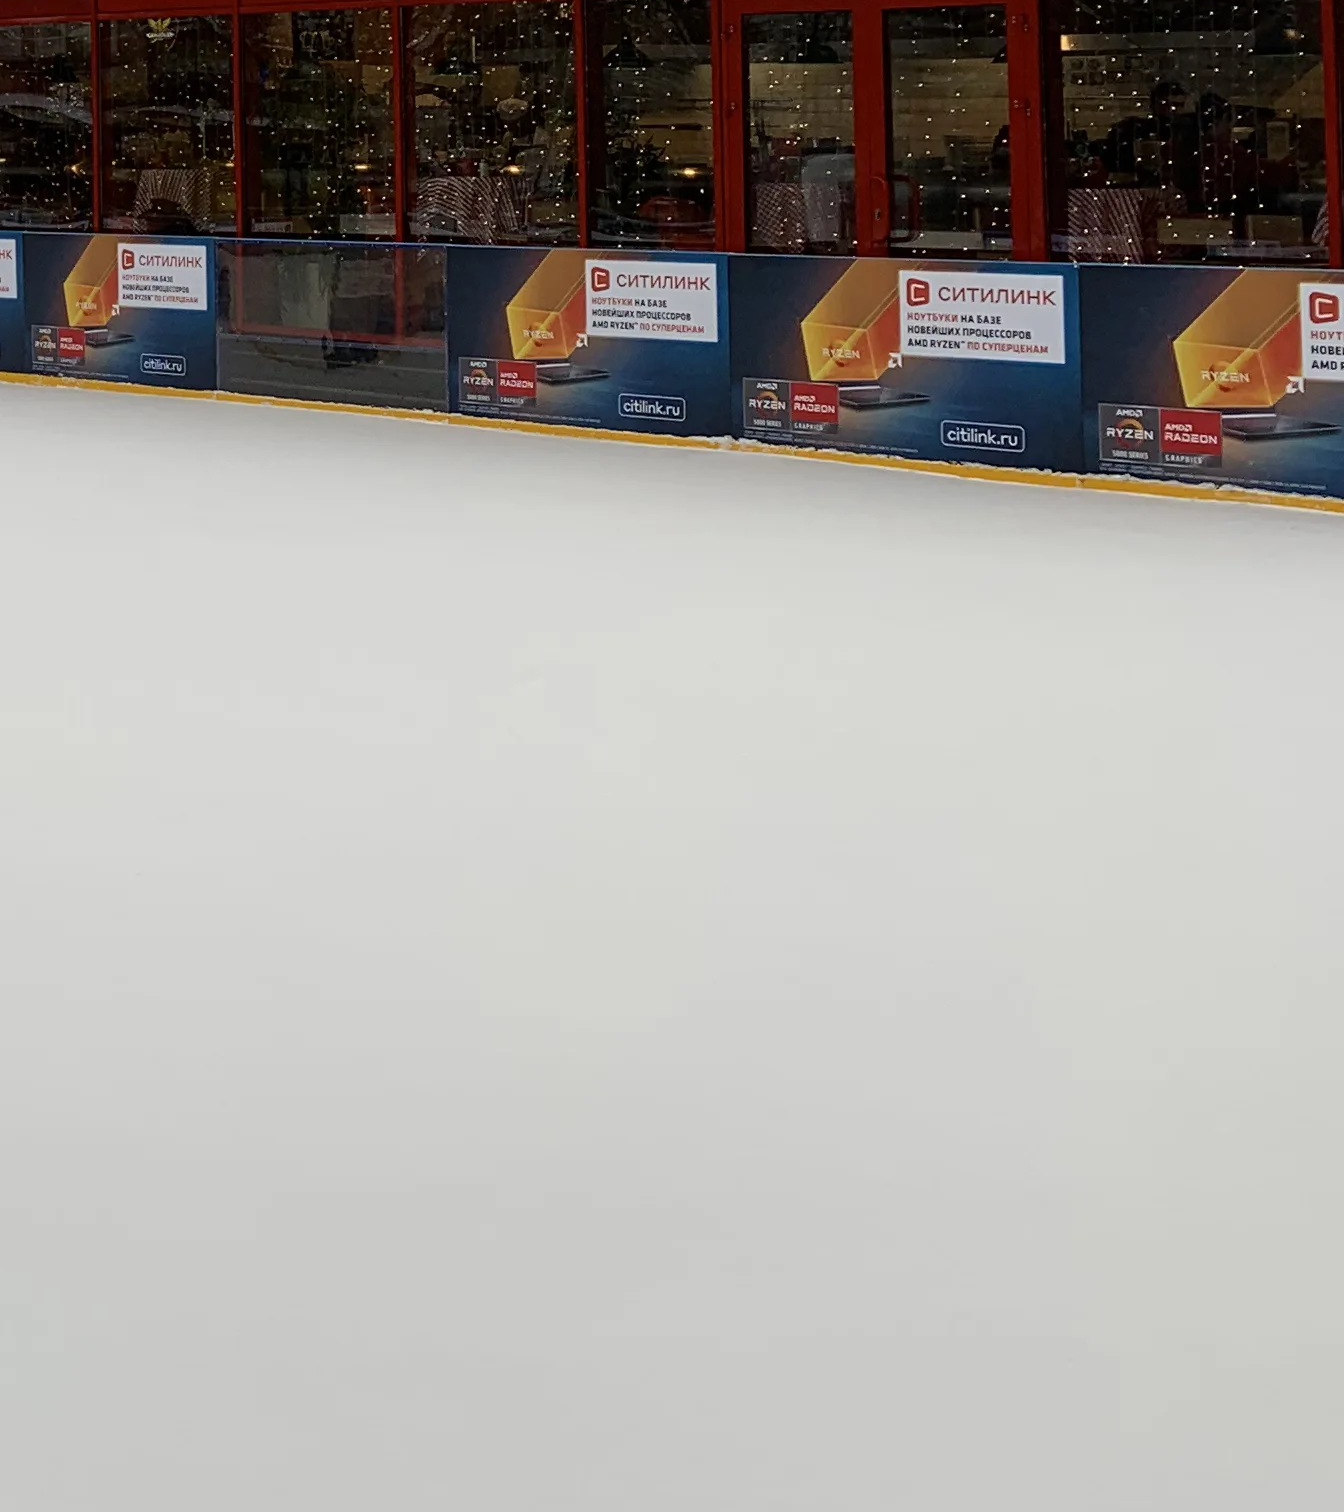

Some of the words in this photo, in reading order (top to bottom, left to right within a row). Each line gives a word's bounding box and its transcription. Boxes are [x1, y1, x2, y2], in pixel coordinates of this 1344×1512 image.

[139, 255, 203, 268] СИТИЛИНК
[616, 274, 711, 291] СИТИЛИНК
[938, 286, 1056, 306] СИТИЛИНК
[591, 297, 633, 306] НОУТБУКИ
[634, 299, 646, 307] НА
[647, 299, 668, 308] БАЗЕ
[592, 308, 635, 319] НОВЕЙШИХ
[635, 310, 692, 321] ПРОЦЕССОРОВ
[907, 313, 958, 323] НОУТБУКИ
[960, 315, 974, 323] НА
[977, 315, 1001, 325] БАЗЕ
[592, 321, 609, 329] AMD
[639, 323, 650, 331] ПО
[651, 324, 705, 335] СУПЕРЦЕНАМ
[907, 325, 961, 336] НОВЕЙШИХ
[963, 328, 1032, 340] ПРОЦЕССОРОВ
[1310, 331, 1344, 341] НОУТ
[822, 347, 861, 359] RYZEN
[908, 340, 928, 348] AMD
[967, 341, 981, 350] ПО
[982, 342, 1049, 354] СУПЕРЦЕНАМ
[143, 358, 182, 372] citilink.ru
[1311, 359, 1338, 370] AMD
[463, 375, 494, 386] RYZEN
[1201, 370, 1250, 383] RYZEN
[500, 379, 534, 389] RADEON
[623, 399, 681, 416] citilink.ru
[748, 399, 786, 411] RYZEN
[794, 404, 836, 414] RADEON
[1116, 409, 1143, 418] AMD
[1164, 423, 1192, 432] AMD
[946, 427, 1018, 447] citilink.ru
[1106, 427, 1154, 441] RYZEN
[1164, 431, 1218, 445] RADEON
[1128, 450, 1148, 460] SERIES
[1165, 455, 1203, 465] GRAPHICS
